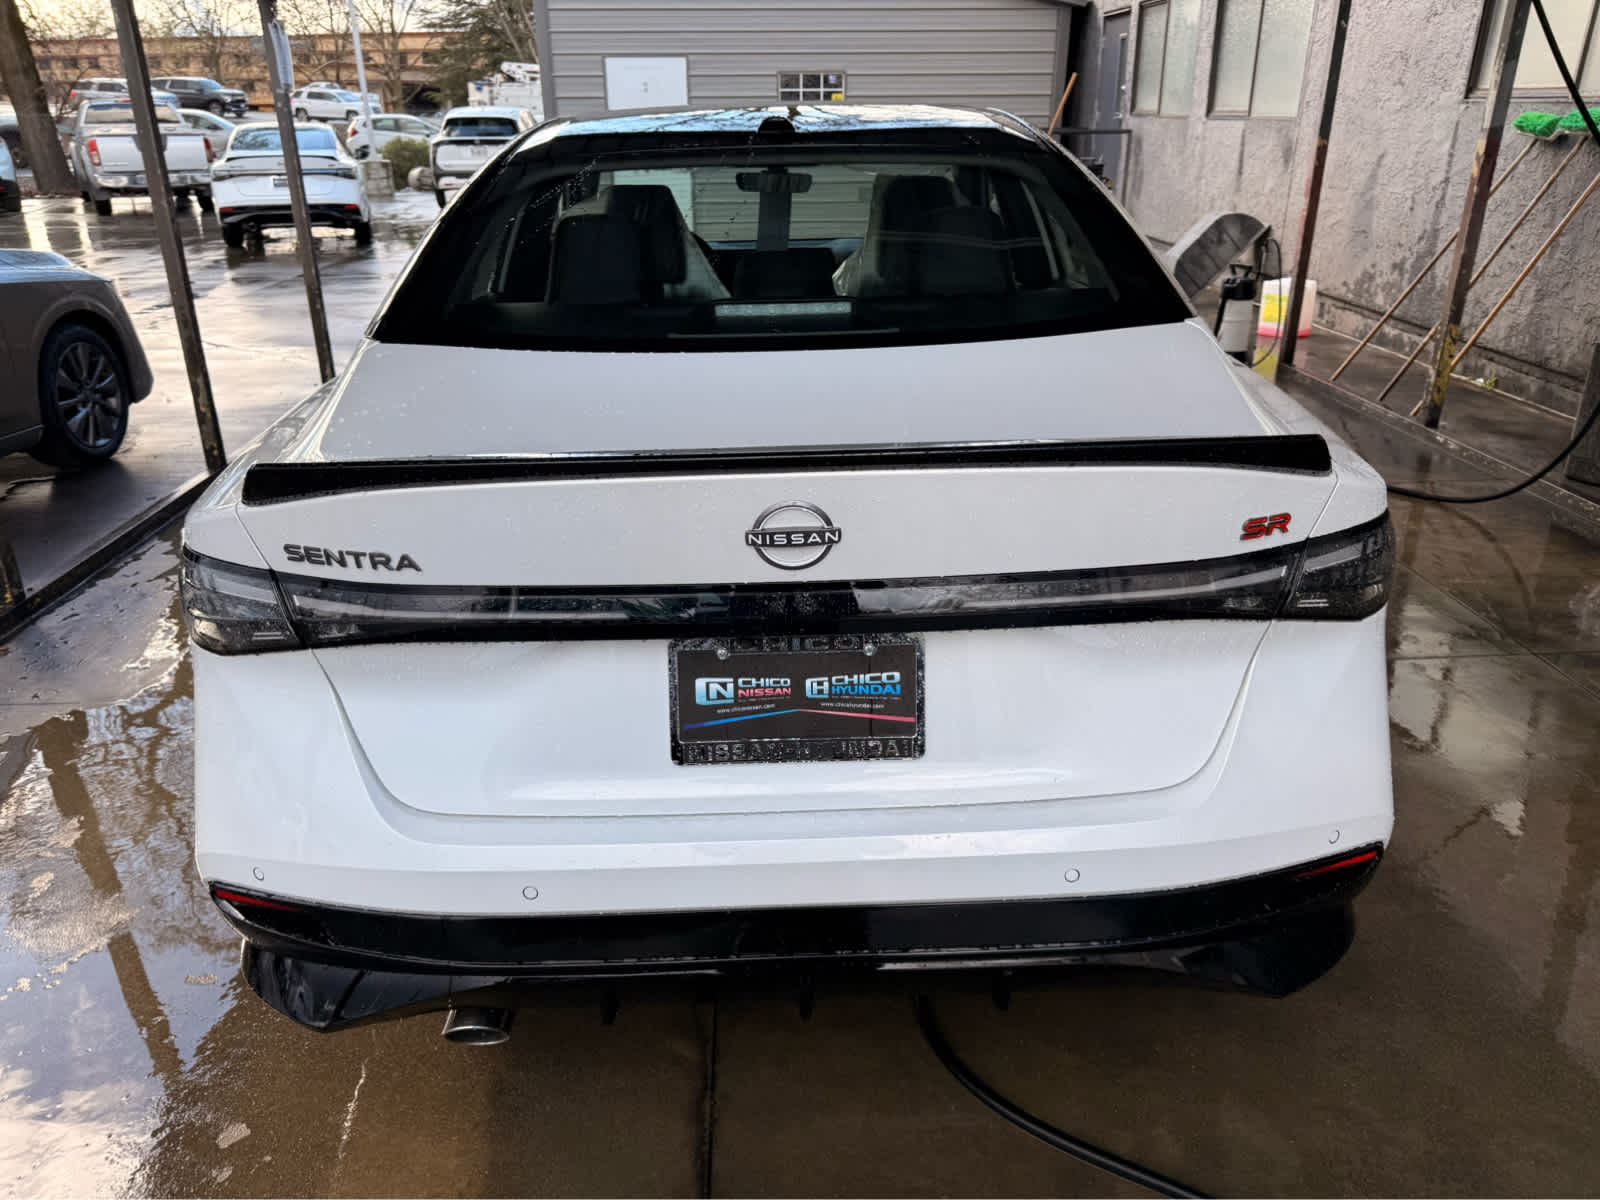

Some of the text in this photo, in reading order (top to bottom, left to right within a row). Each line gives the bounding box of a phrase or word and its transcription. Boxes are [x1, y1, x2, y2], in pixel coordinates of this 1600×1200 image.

[1240, 512, 1292, 541] SR
[748, 531, 839, 545] NISSAN
[283, 543, 422, 572] SENTRA
[737, 677, 791, 688] CHICO
[831, 671, 901, 686] CHICO
[737, 688, 791, 698] NISSAN
[831, 684, 902, 696] HYUNDAI
